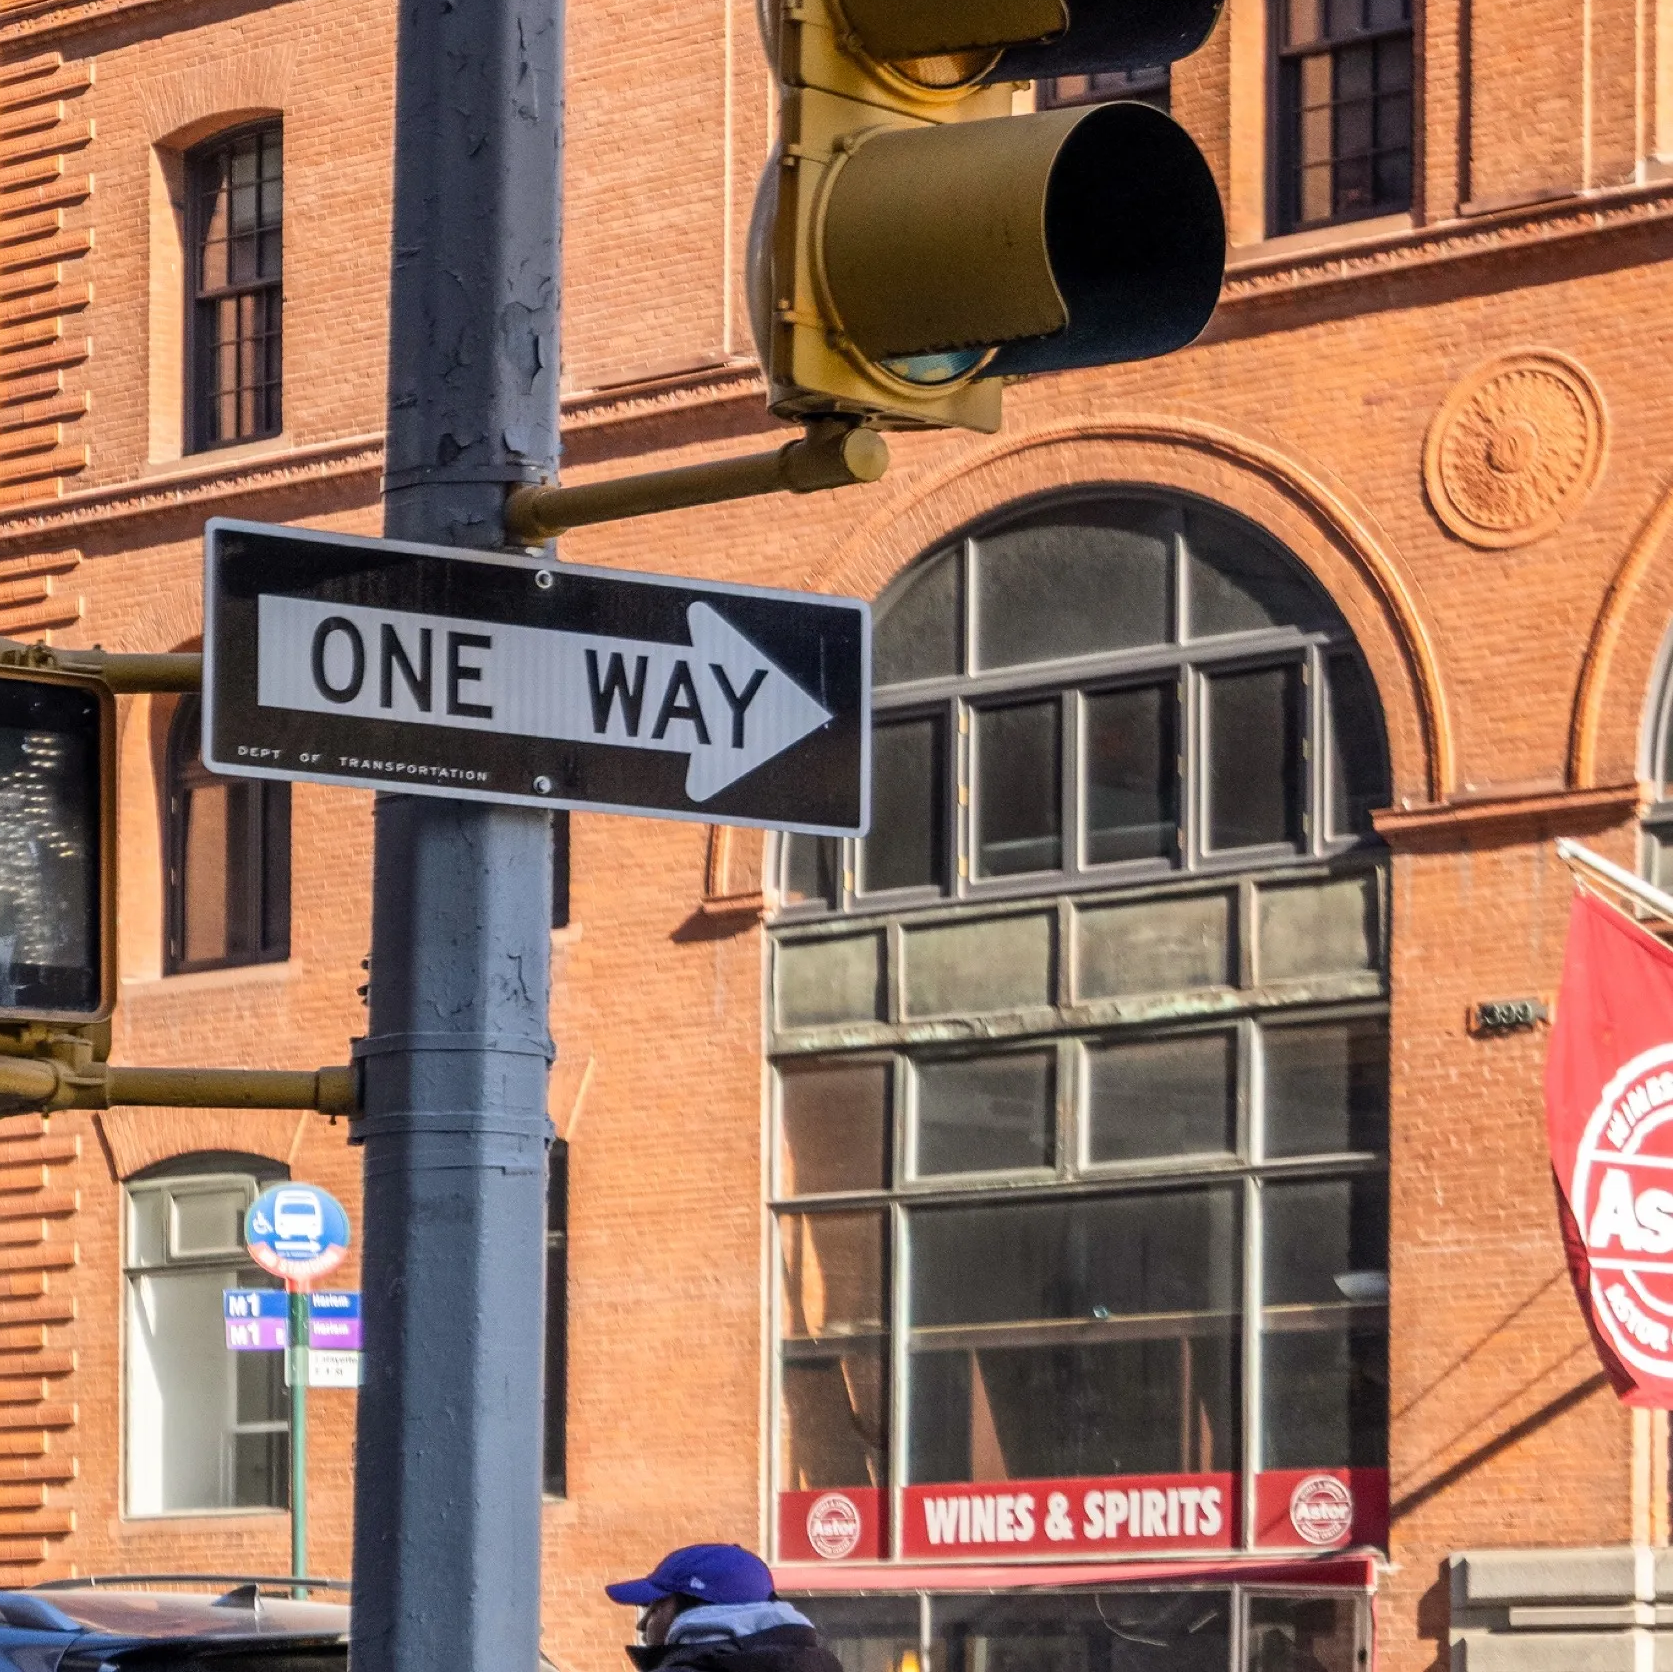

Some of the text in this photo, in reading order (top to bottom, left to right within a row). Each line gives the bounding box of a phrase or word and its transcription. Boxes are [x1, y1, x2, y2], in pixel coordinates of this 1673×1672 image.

[310, 615, 769, 750] ONE WAY
[237, 744, 489, 783] DEPT OF TRANSPORTATION
[228, 1292, 261, 1317] M1
[229, 1321, 261, 1346] M1
[923, 1486, 1224, 1545] WINES & SPIRITS
[1296, 1500, 1348, 1520] Astor
[811, 1517, 856, 1537] Astor
